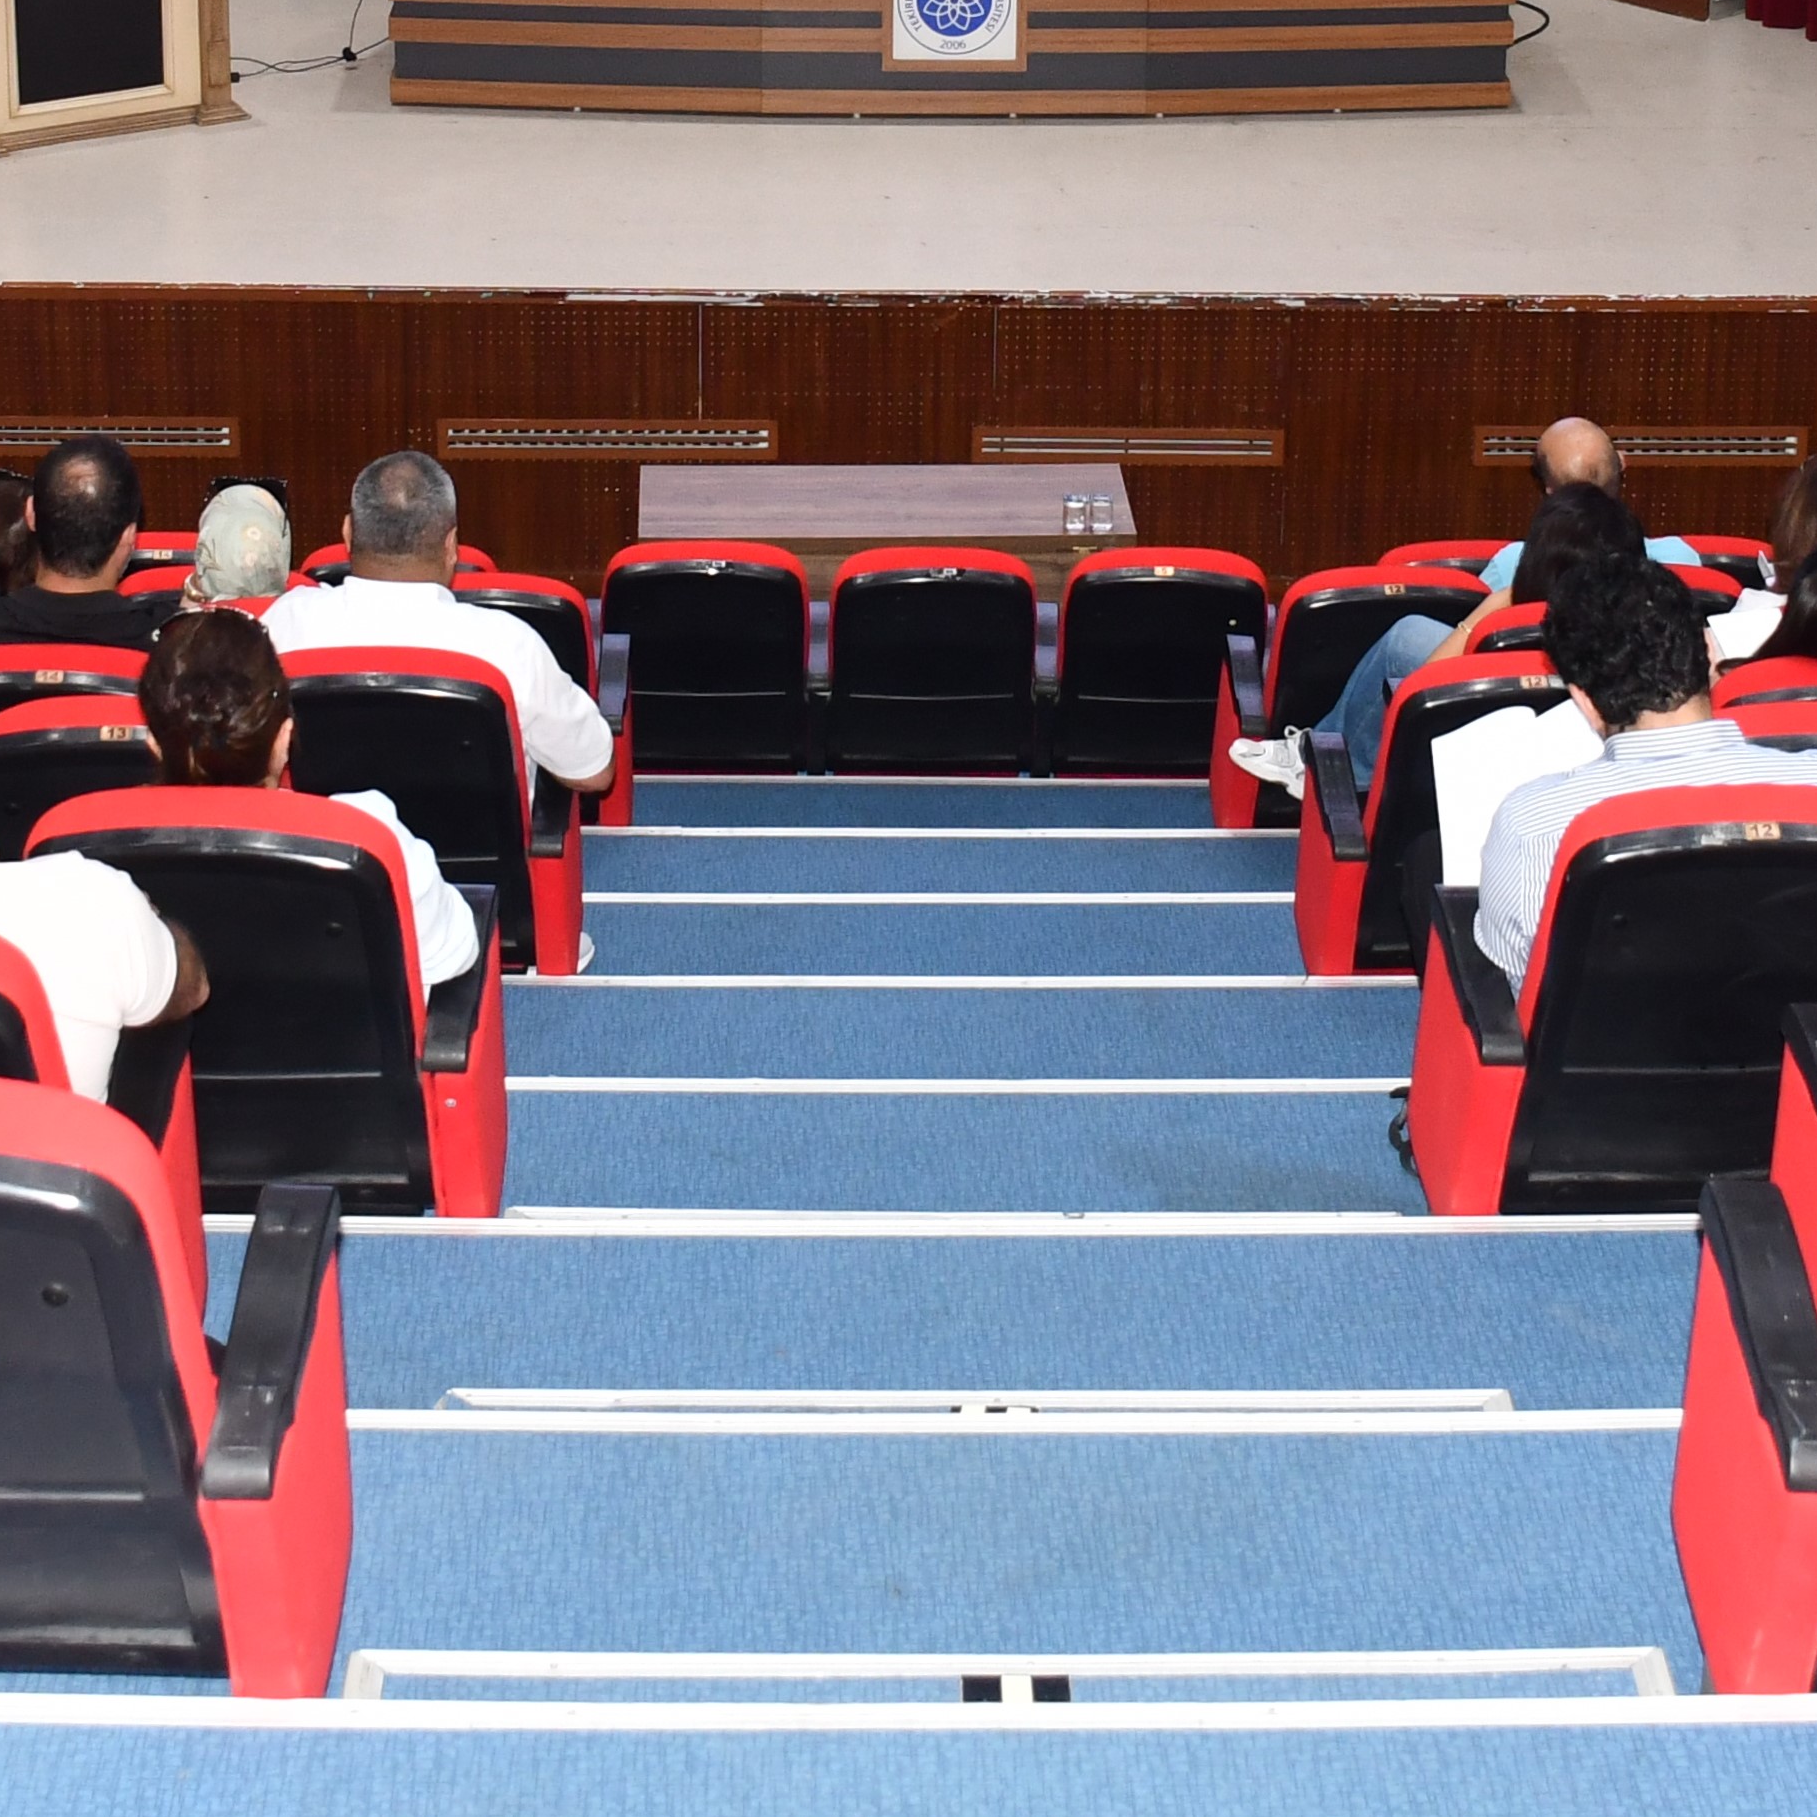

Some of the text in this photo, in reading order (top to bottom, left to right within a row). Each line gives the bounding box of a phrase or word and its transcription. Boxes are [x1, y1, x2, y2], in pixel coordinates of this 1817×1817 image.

[940, 39, 966, 50] 2006
[1388, 585, 1401, 593] 12
[1525, 676, 1543, 687] 12
[108, 727, 127, 738] 13
[1750, 824, 1774, 838] 12
